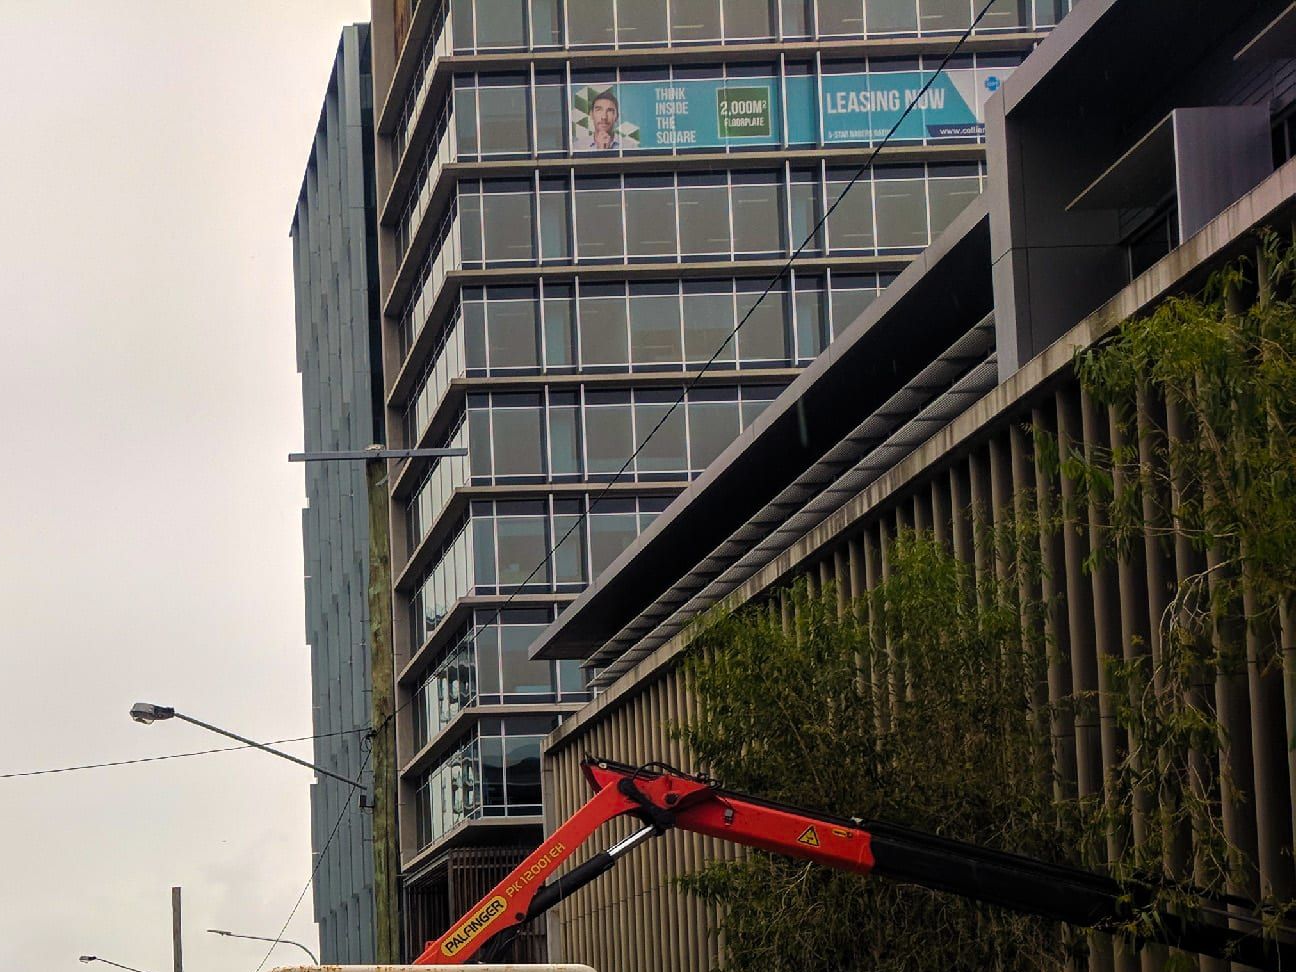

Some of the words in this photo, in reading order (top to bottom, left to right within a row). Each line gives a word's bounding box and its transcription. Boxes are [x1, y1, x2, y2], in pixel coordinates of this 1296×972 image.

[655, 88, 686, 101] THINK
[826, 90, 901, 114] LEASING
[904, 87, 945, 112] NOW
[655, 102, 689, 115] INSIDE
[656, 116, 675, 130] THE
[723, 117, 765, 127] FLOORPLATE
[656, 131, 697, 144] SQUARE
[505, 881, 523, 898] PK
[547, 842, 567, 860] EH
[444, 899, 505, 954] PALFINGER
